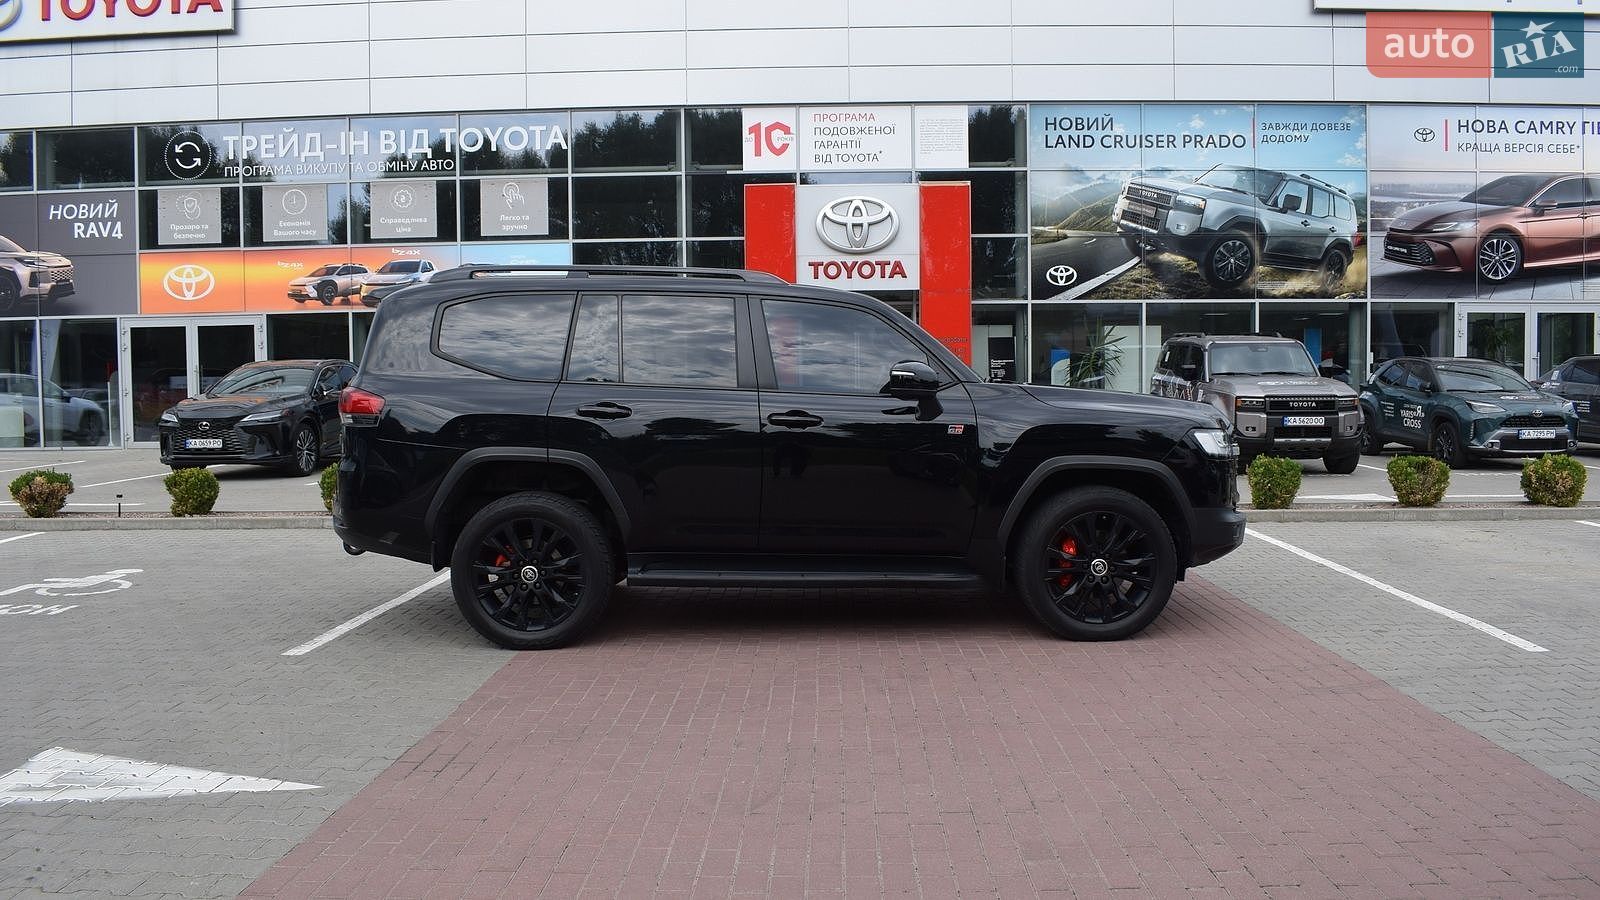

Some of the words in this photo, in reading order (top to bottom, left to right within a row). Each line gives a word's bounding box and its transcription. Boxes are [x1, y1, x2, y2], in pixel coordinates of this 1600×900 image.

[813, 113, 876, 122] ПРОГРАМА
[1045, 113, 1114, 131] НОВИЙ
[813, 123, 896, 137] ПОДОВЖЕНОЇ
[1261, 122, 1308, 133] ЗАВЖДИ
[1310, 122, 1352, 133] ДОВЕЗЕ
[1457, 119, 1509, 134] НОВА
[1514, 120, 1577, 135] CAMRY
[1581, 121, 1600, 135] ГІ
[222, 127, 369, 162] ТРЕЙД-ІН
[379, 128, 433, 159] ВІД
[439, 125, 569, 153] TOYOTA
[814, 138, 862, 149] ГАРАНТІЇ
[1045, 134, 1095, 149] LAND
[1100, 134, 1177, 149] CRUISER
[1182, 134, 1247, 149] PRADO
[1261, 134, 1310, 145] ДОДОМУ
[1457, 142, 1501, 155] КРАЩА
[1504, 143, 1544, 153] ВЕРСІЯ
[814, 153, 833, 164] ВІД
[224, 165, 293, 178] ПРОГРАМА
[296, 163, 345, 175] ВИКУПУ
[367, 160, 418, 172] ОБМІНУ
[421, 159, 455, 171] АВТО
[49, 199, 119, 220] НОВИЙ
[73, 221, 123, 240] RAV4
[808, 260, 907, 280] TOYOTA
[1403, 418, 1422, 429] CROSS
